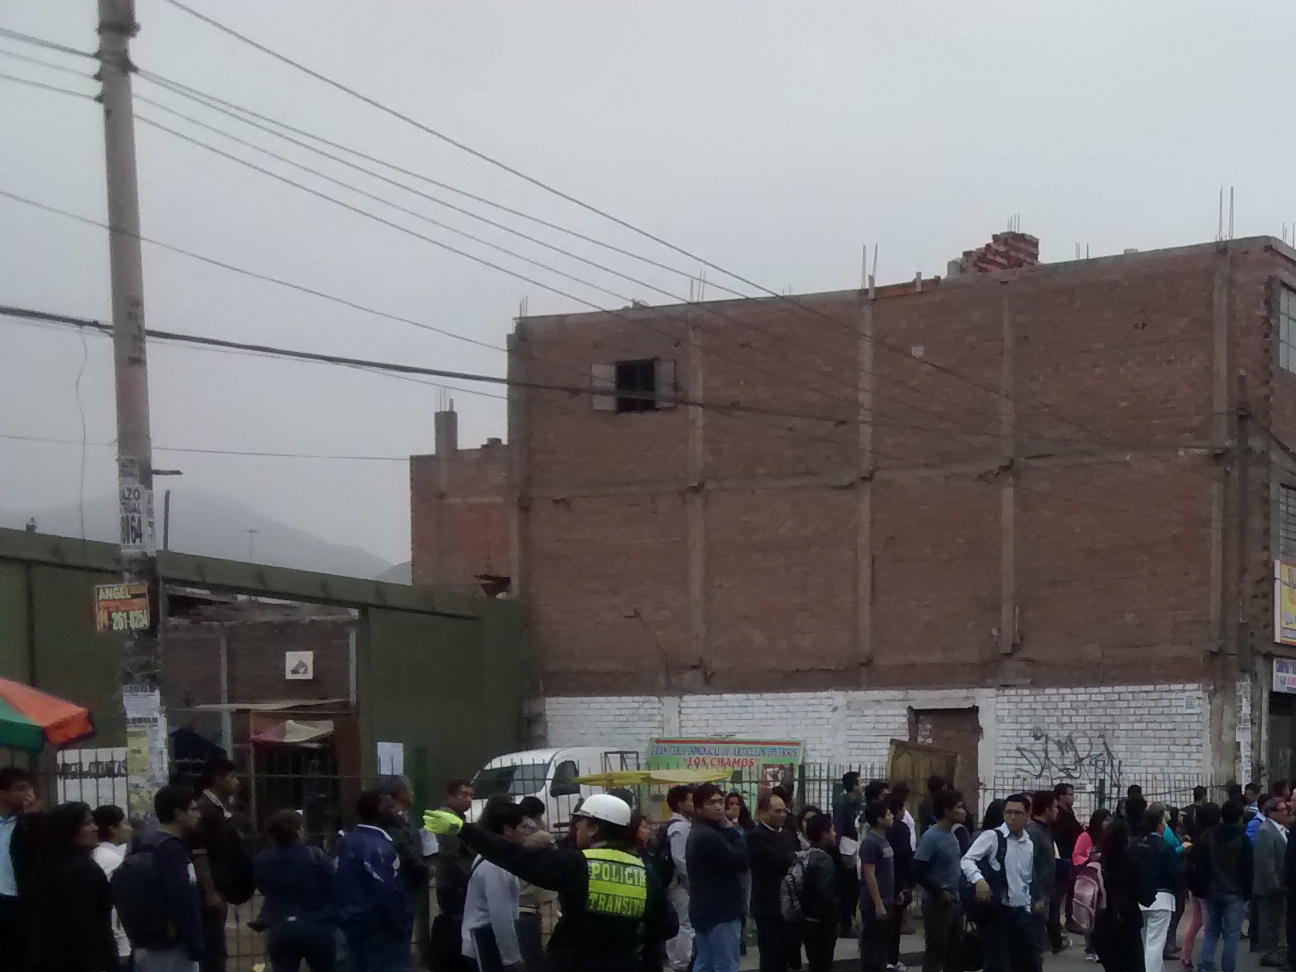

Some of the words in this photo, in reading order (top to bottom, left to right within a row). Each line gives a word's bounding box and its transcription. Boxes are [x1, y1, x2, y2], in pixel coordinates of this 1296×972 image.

[99, 586, 132, 600] ANGEL
[590, 862, 646, 887] POLICIA
[589, 892, 646, 916] TRANSITO
